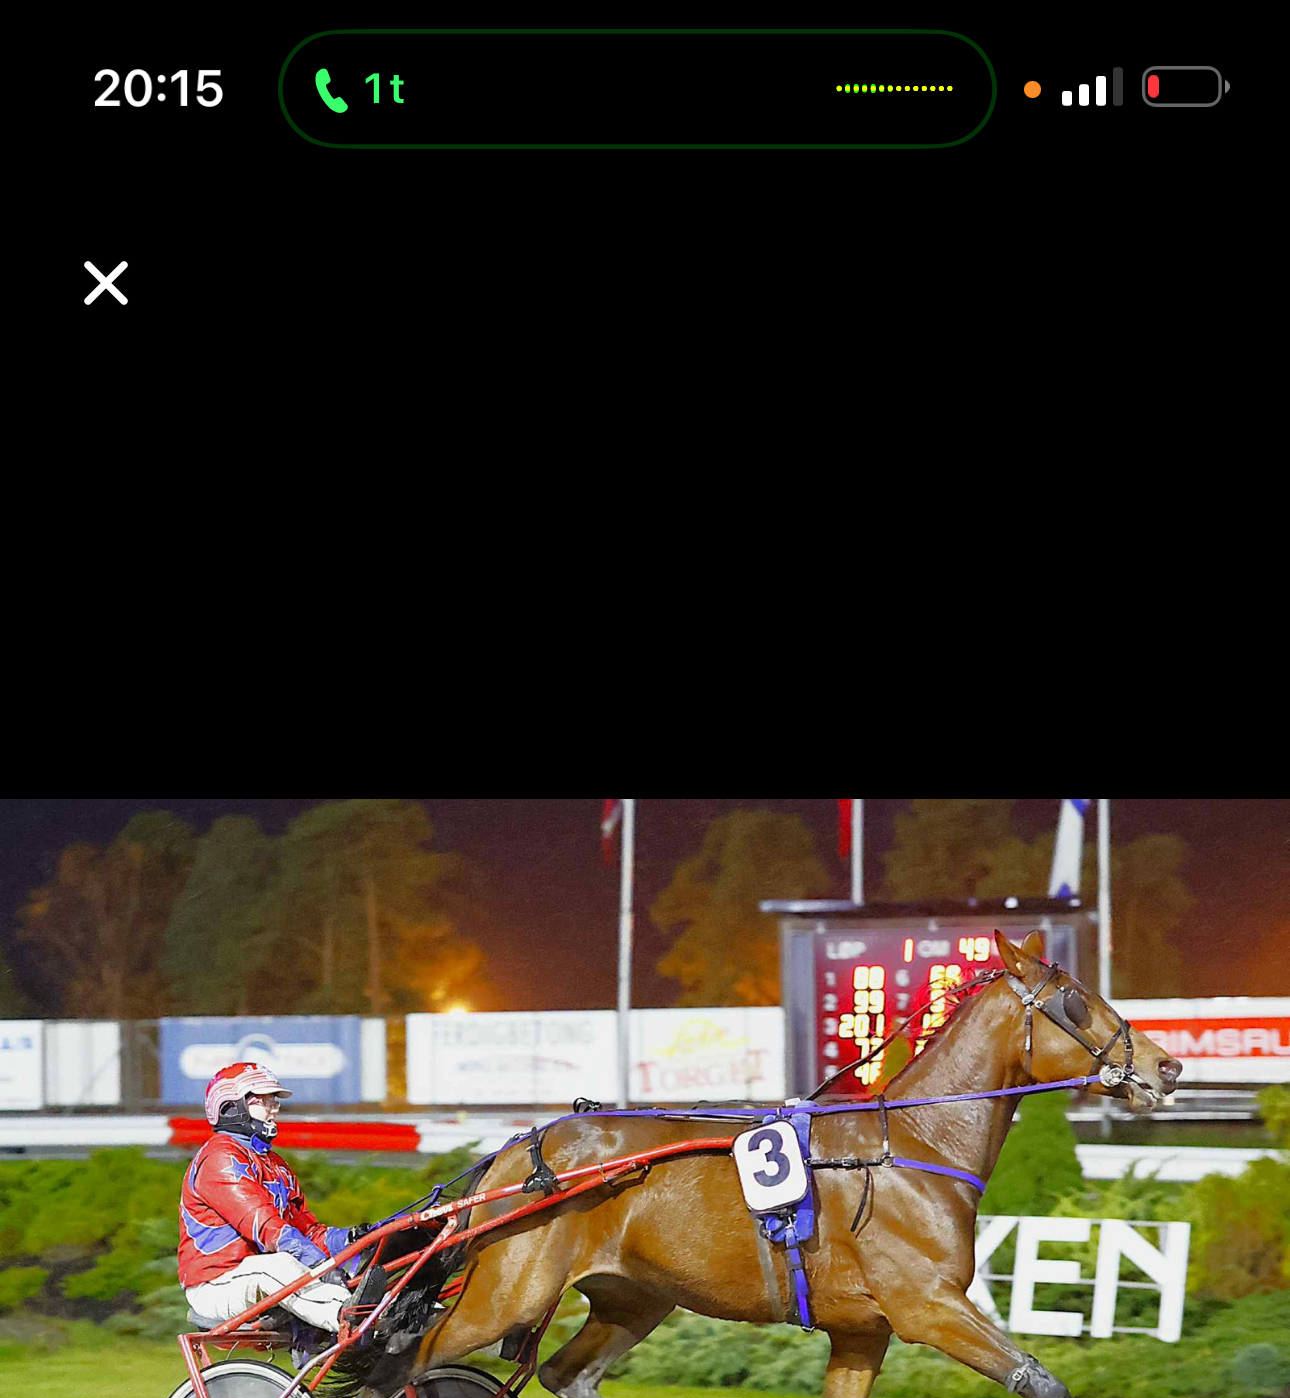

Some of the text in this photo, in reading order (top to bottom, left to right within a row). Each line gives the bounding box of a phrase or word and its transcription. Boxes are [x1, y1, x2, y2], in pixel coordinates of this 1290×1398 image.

[958, 937, 991, 962] 49
[853, 989, 885, 1014] 99
[747, 1128, 791, 1188] 3
[457, 1193, 487, 1209] SAFER
